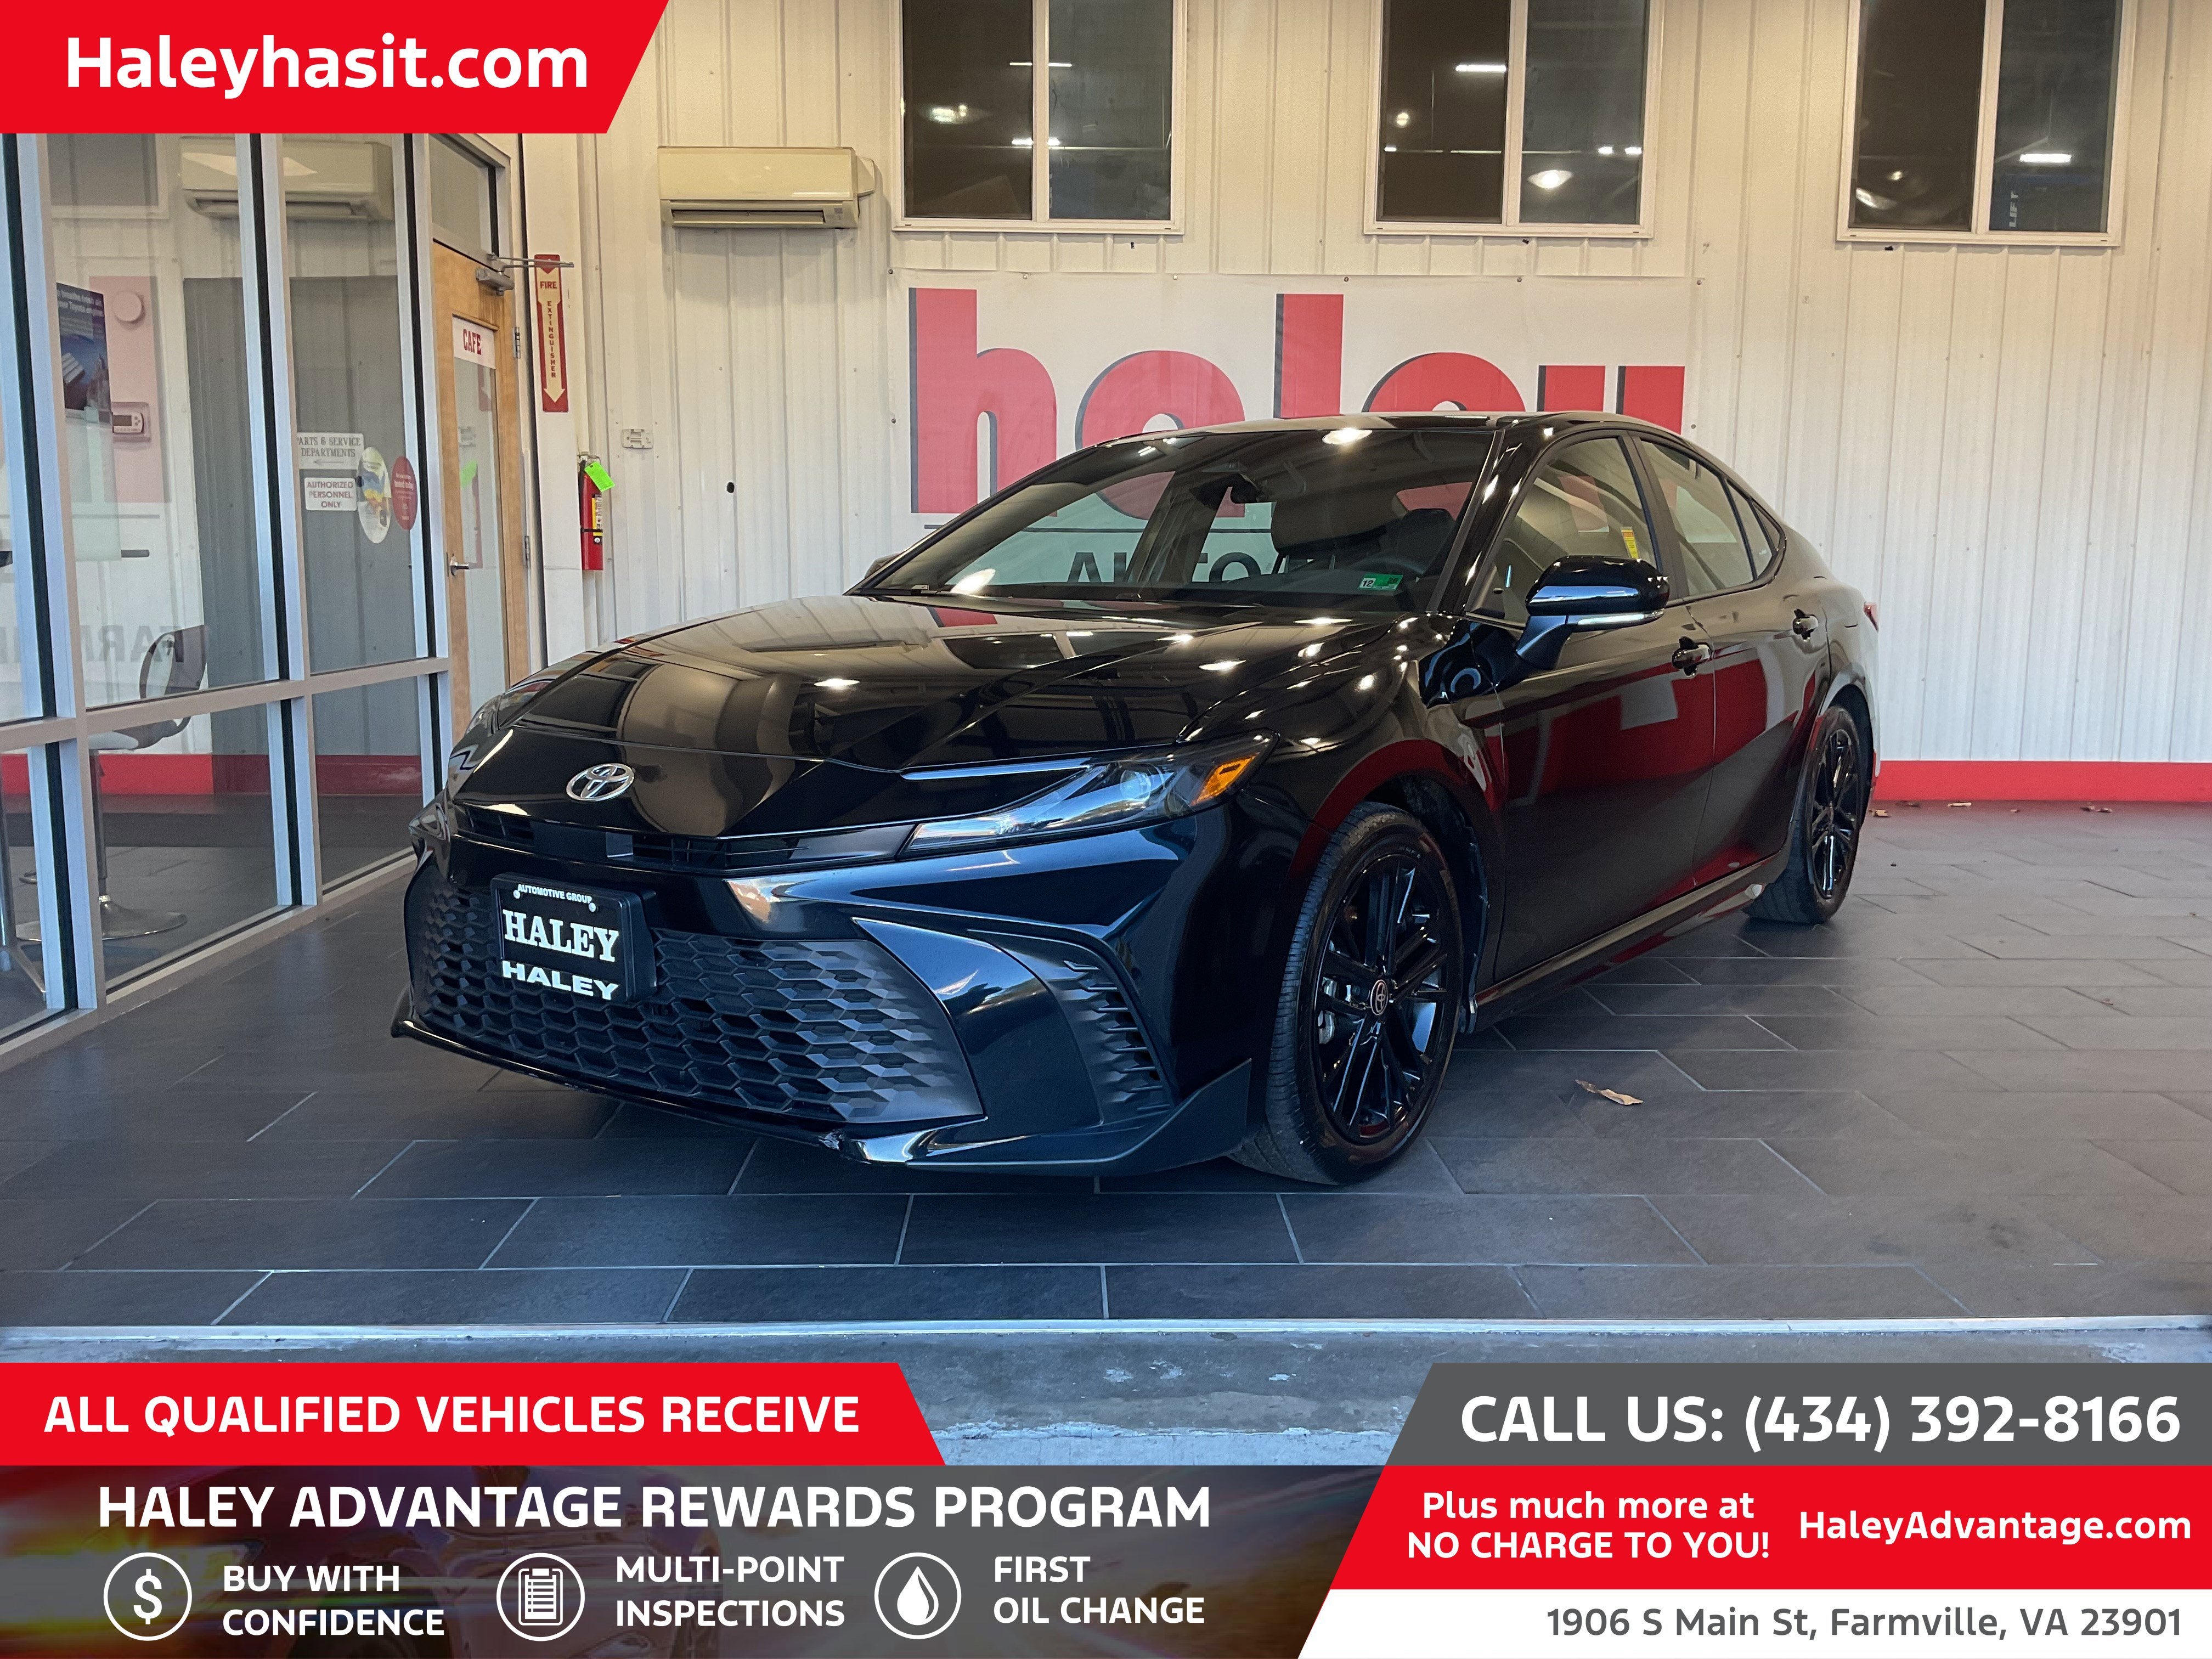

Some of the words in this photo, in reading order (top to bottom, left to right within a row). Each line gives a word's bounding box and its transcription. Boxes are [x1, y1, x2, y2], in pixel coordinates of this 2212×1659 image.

[463, 329, 482, 355] CAFE
[547, 301, 556, 378] EXTINGUISHER
[301, 448, 356, 457] DEPARTMENTS
[329, 437, 361, 445] SERVICE
[517, 884, 565, 900] AUTOMOTIVE
[566, 892, 592, 904] GROUP
[503, 909, 619, 962] HALEY
[502, 960, 619, 1001] HALEY
